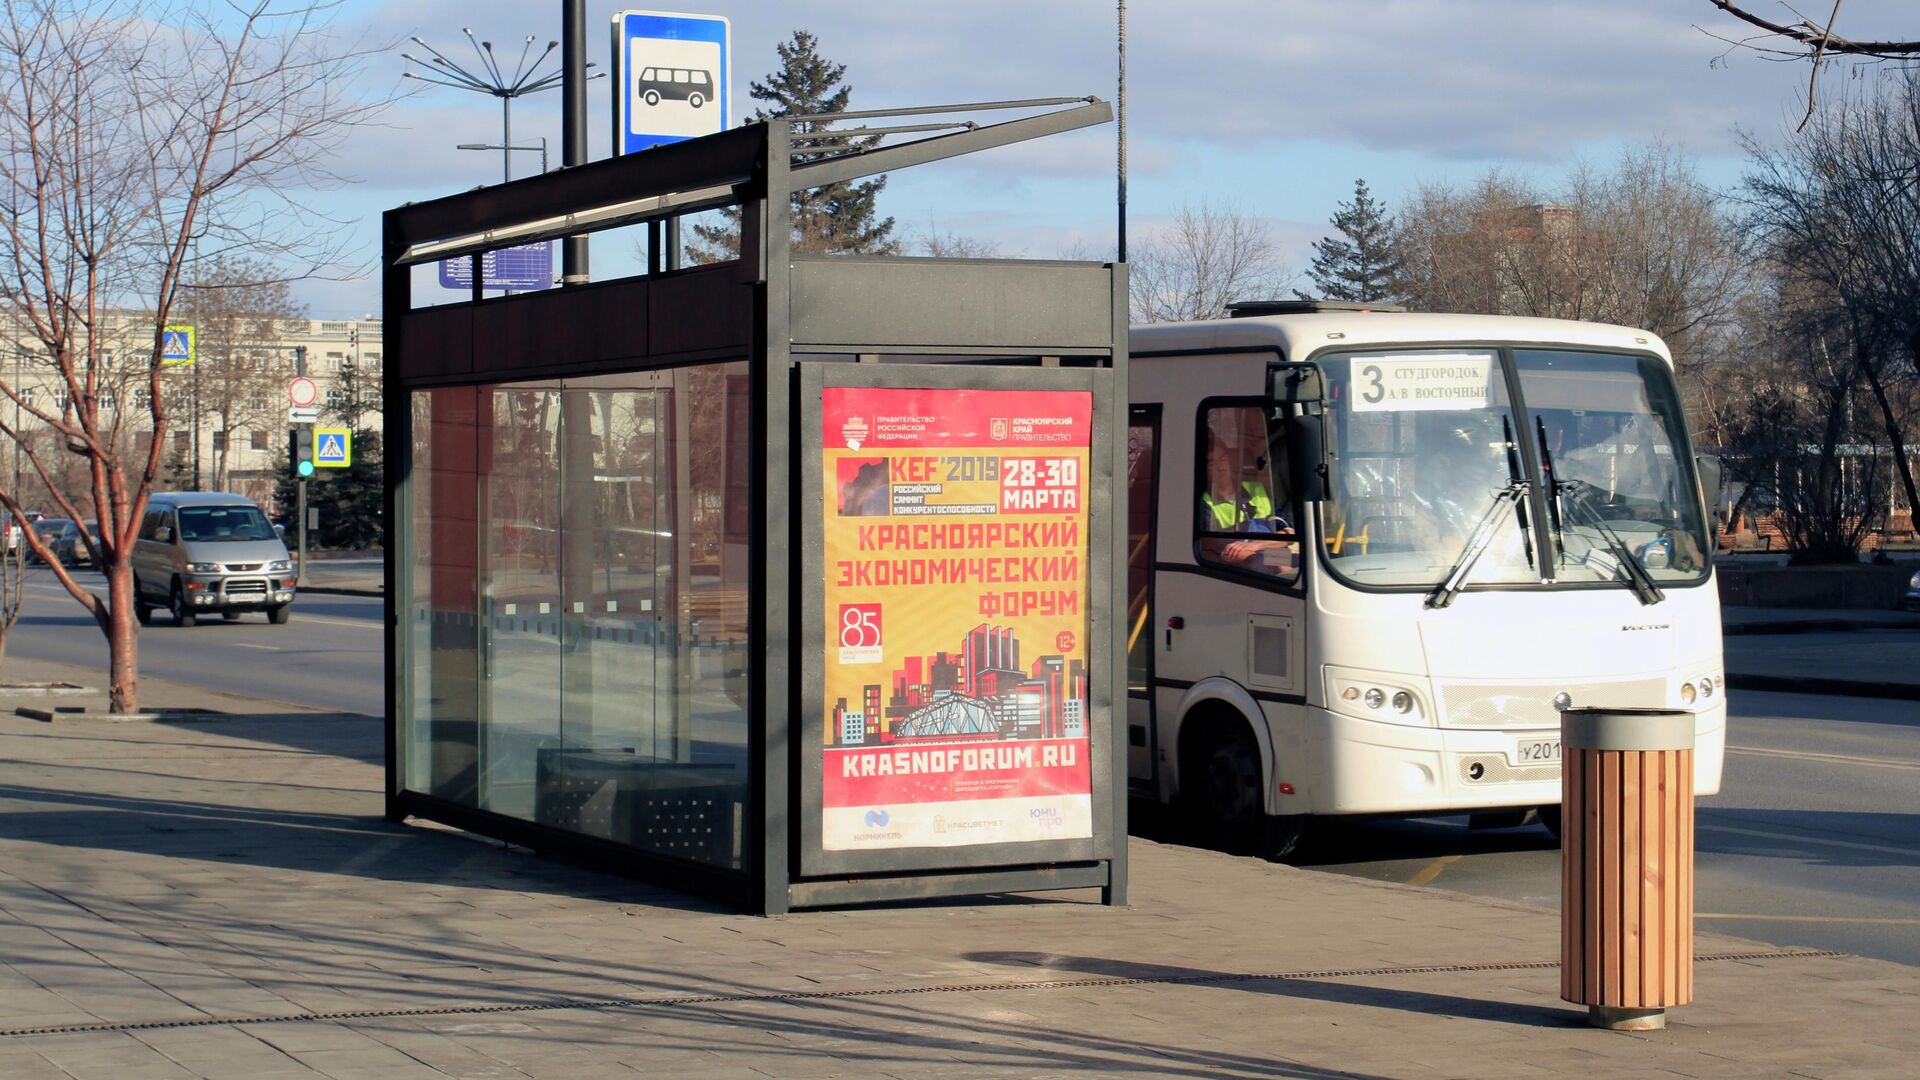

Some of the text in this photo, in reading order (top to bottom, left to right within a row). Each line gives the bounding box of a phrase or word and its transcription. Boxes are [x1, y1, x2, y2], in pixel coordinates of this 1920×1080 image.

[1362, 365, 1385, 404] 3
[1415, 385, 1489, 399] ВОСТОЧНЫЙ
[1012, 416, 1073, 425] КРАСНОЯРСКИЙ
[1012, 425, 1033, 433] КРАЙ
[1012, 433, 1072, 441] ПРАВИТЕЛЬСТВО
[1003, 459, 1077, 487] 28-30
[893, 484, 942, 494] РОССИЙСКИЙ
[893, 496, 923, 504] САММИТ
[1004, 489, 1077, 509] МАРТА
[893, 505, 996, 515] КОНКУРЕНТОСПОСОБНОСТИ
[859, 516, 1078, 551] КРАСНОЯРСКИЙ
[837, 550, 1078, 587] ЭКОНОМИЧЕСКИЙ
[979, 591, 1077, 618] ФОРУМ
[841, 607, 880, 648] 85
[1058, 634, 1076, 648] 12+
[842, 744, 1077, 778] KRASNOFORUM.RU
